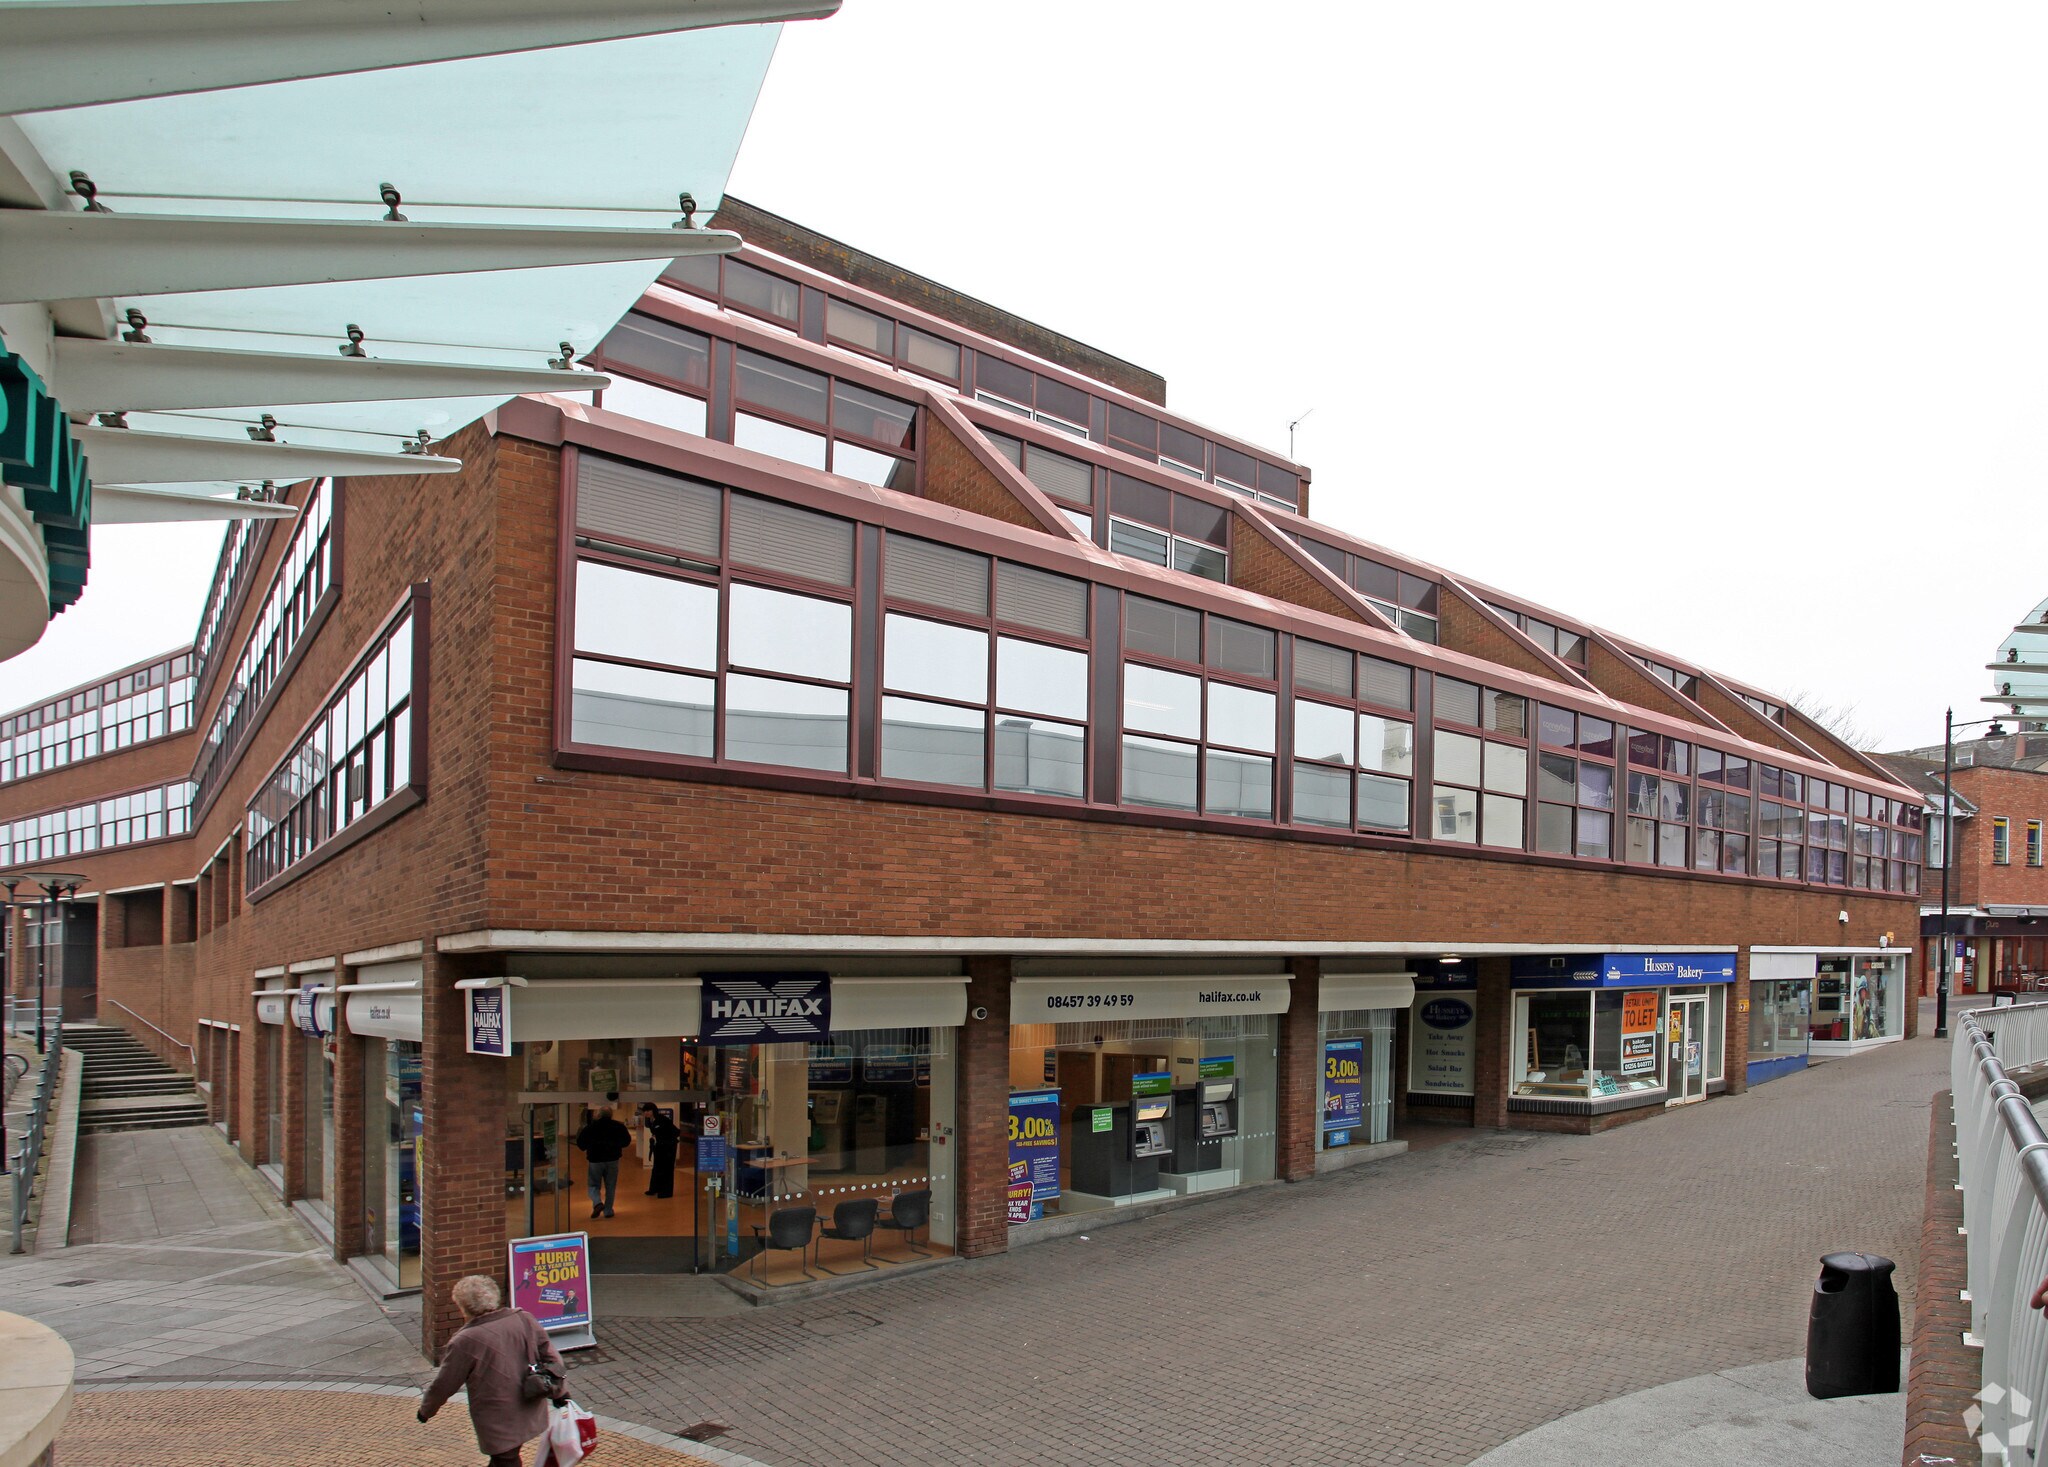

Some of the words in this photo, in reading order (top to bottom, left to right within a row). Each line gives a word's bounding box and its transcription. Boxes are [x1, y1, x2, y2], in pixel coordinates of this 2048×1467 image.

[1644, 957, 1675, 972] HUSSEYS
[1677, 965, 1704, 980] Bakery
[1047, 996, 1085, 1008] 08457
[1087, 995, 1101, 1007] 39
[1103, 994, 1118, 1007] 49
[1120, 994, 1134, 1006] 59
[1199, 991, 1262, 1003] halifax.co.uk
[711, 998, 823, 1018] HALIFAX
[473, 1012, 502, 1029] HALIFAX
[1625, 1010, 1636, 1027] TO
[1637, 1008, 1655, 1026] LET
[1427, 1033, 1444, 1041] Take
[1446, 1033, 1464, 1041] Away
[1449, 1065, 1463, 1073] Bar
[1424, 1080, 1465, 1088] Sandwiches
[1008, 1187, 1032, 1198] URRY!
[534, 1251, 578, 1265] HURRY
[536, 1265, 579, 1287] SOON
